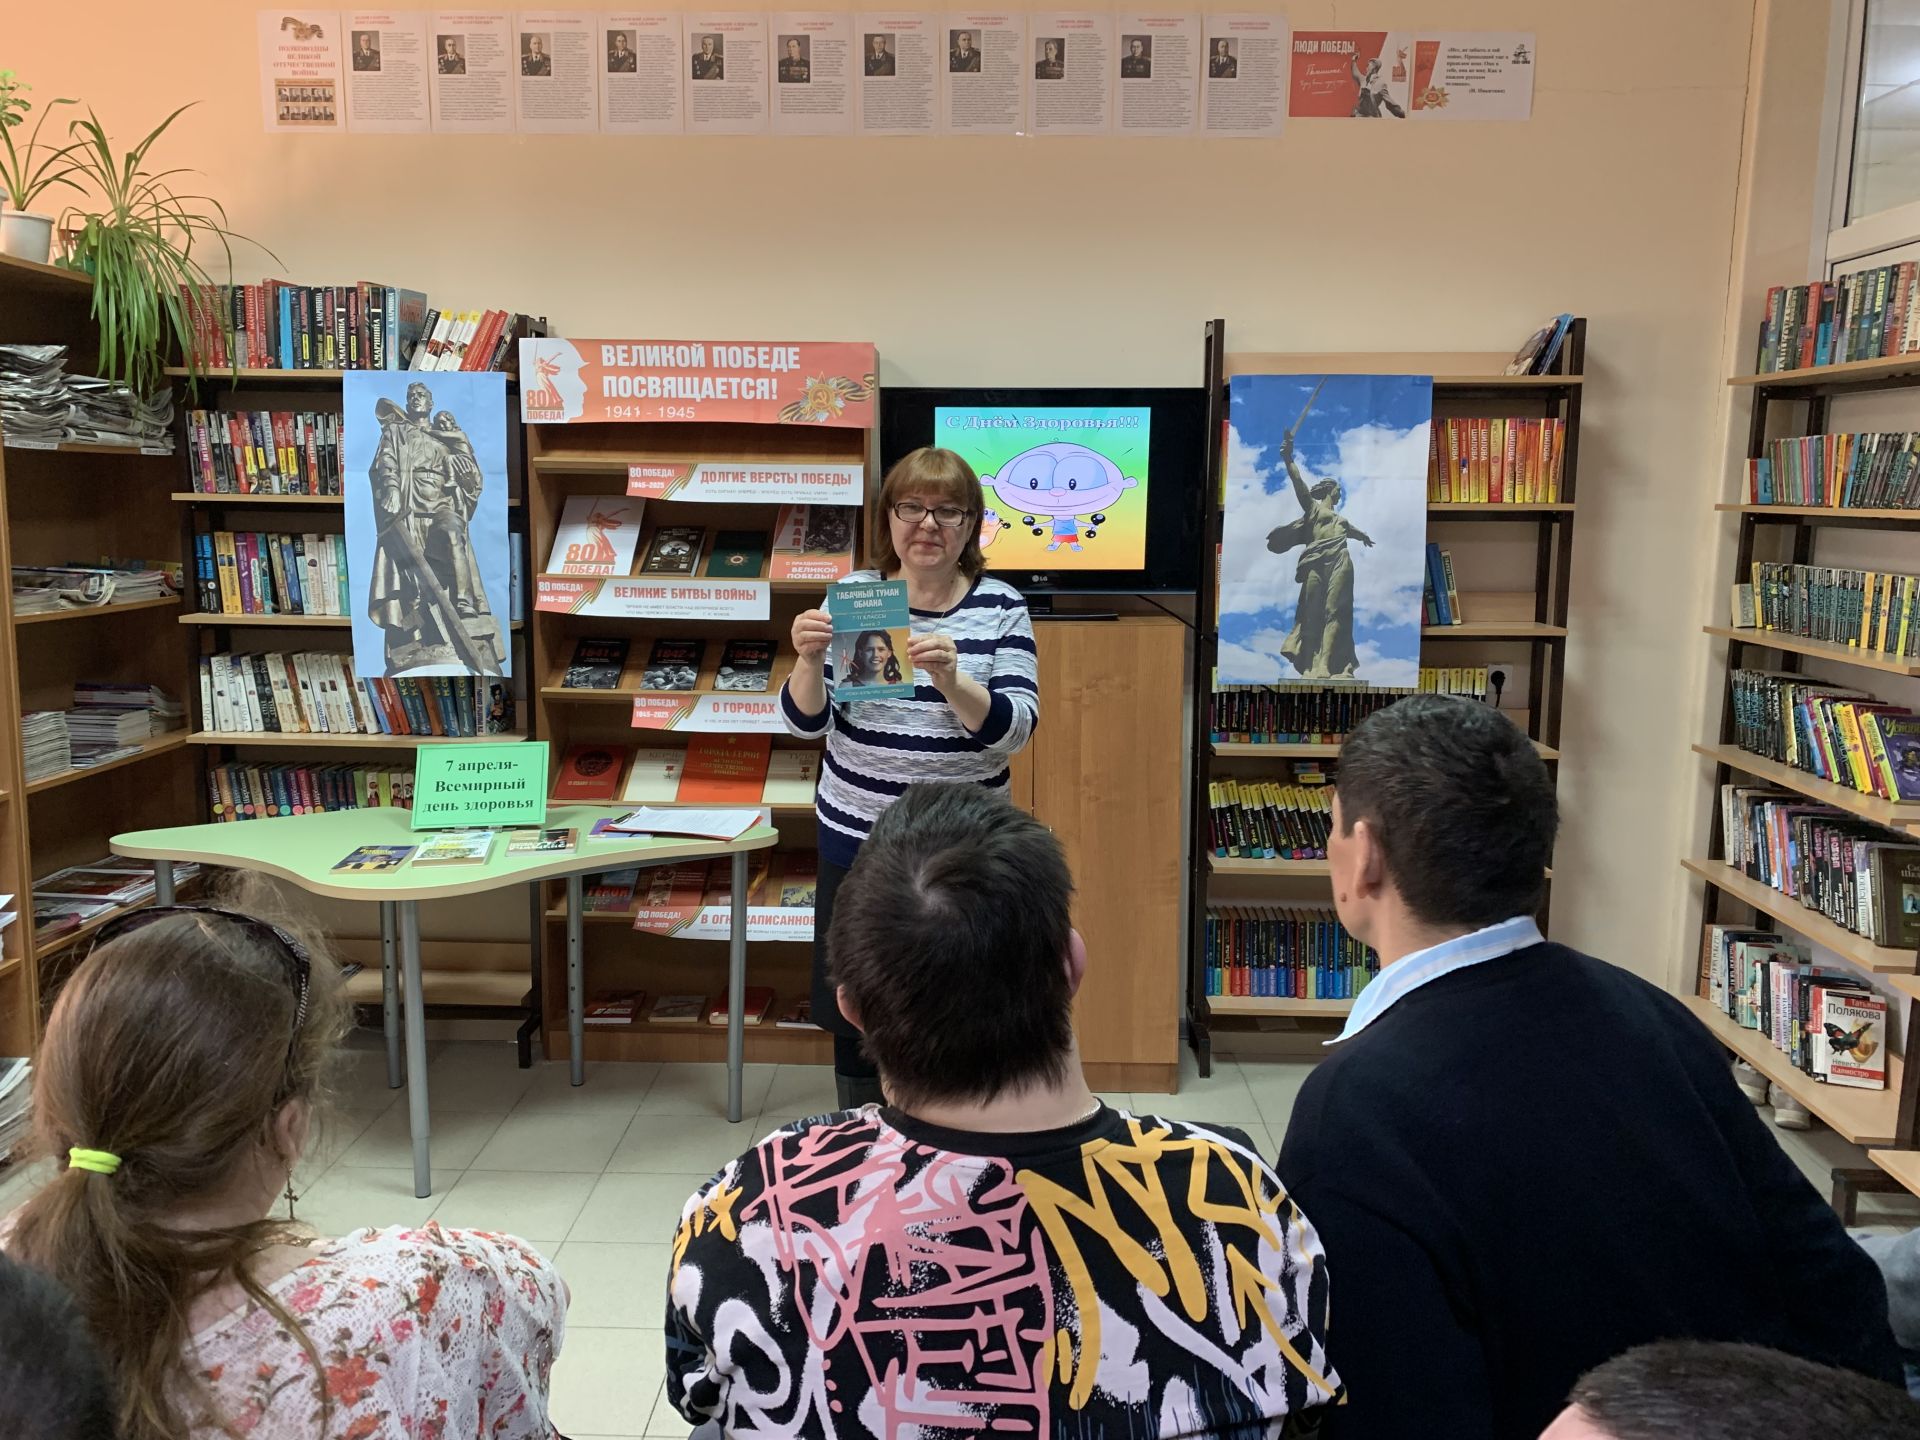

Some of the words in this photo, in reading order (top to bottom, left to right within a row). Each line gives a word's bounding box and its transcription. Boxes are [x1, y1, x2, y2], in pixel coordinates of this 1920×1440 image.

[1294, 41, 1319, 54] ЛЮДИ
[1321, 41, 1355, 54] ПОБЕДЫ
[601, 343, 705, 368] ВЕЛИКОЙ
[712, 346, 801, 373] ПОБЕДЕ
[602, 375, 778, 402] ПОСВЯЩАЕТСЯ!
[526, 389, 550, 408] 80
[526, 410, 566, 421] ПОБЕДА!
[604, 405, 641, 419] 1941
[657, 406, 696, 419] 1945
[946, 416, 960, 428] С
[963, 415, 1020, 430] Днём
[1023, 416, 1139, 430] Здоровья!!!
[1508, 429, 1517, 461] ШИЛОВА
[629, 467, 641, 477] 80
[642, 468, 675, 478] ПОБЕДА!
[700, 470, 746, 484] ДОЛГИЕ
[750, 472, 798, 484] ВЕРСТЫ
[801, 472, 852, 486] ПОБЕДЫ
[565, 544, 592, 562] 80
[562, 564, 615, 575] ПОБЕДА!
[792, 565, 838, 574] ВЕЛИКОЙ
[539, 582, 550, 591] 80
[551, 583, 583, 592] ПОБЕДА!
[614, 586, 667, 599] ВЕЛИКИЕ
[671, 588, 711, 600] БИТВЫ
[715, 588, 757, 600] ВОЙНЫ
[836, 588, 874, 600] ТАБАЧНЫЙ
[876, 588, 900, 597] ТУМАН
[854, 599, 883, 609] ОБМАНА
[635, 698, 646, 707] 80
[647, 698, 678, 707] ПОБЕДА!
[712, 702, 720, 712] О
[723, 702, 775, 715] ГОРОДАХ
[446, 760, 454, 771] 7
[459, 761, 518, 772] апреля-
[435, 778, 526, 792] Всемирный
[423, 800, 459, 813] день
[464, 799, 534, 811] здоровья
[638, 910, 649, 918] 80
[650, 911, 681, 919] ПОБЕДА!
[700, 914, 708, 924] В
[712, 914, 731, 924] ОГН
[1851, 999, 1881, 1009] Татьяна
[1828, 1003, 1881, 1020] Полякова
[1831, 1065, 1869, 1078] Калиостро
